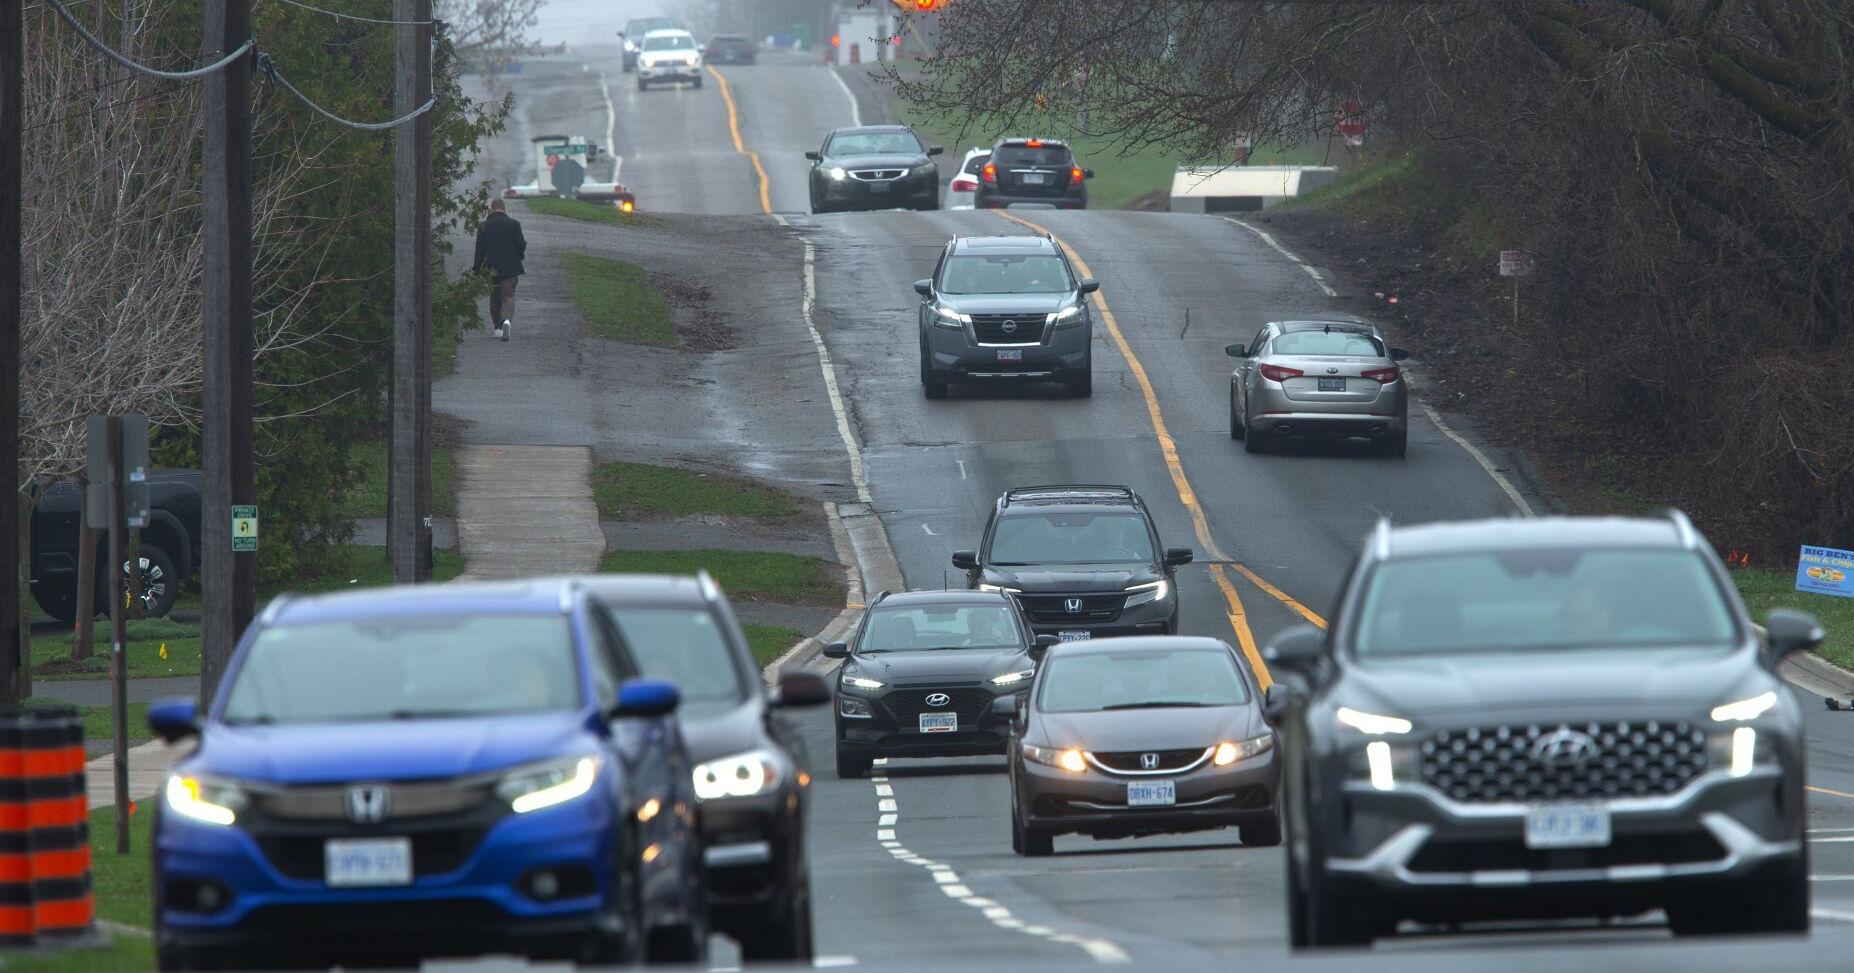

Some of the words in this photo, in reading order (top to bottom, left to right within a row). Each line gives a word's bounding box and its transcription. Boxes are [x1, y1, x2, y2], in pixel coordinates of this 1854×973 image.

[1804, 548, 1824, 556] BIG
[1801, 555, 1820, 563] Fish
[1832, 559, 1854, 568] Chip
